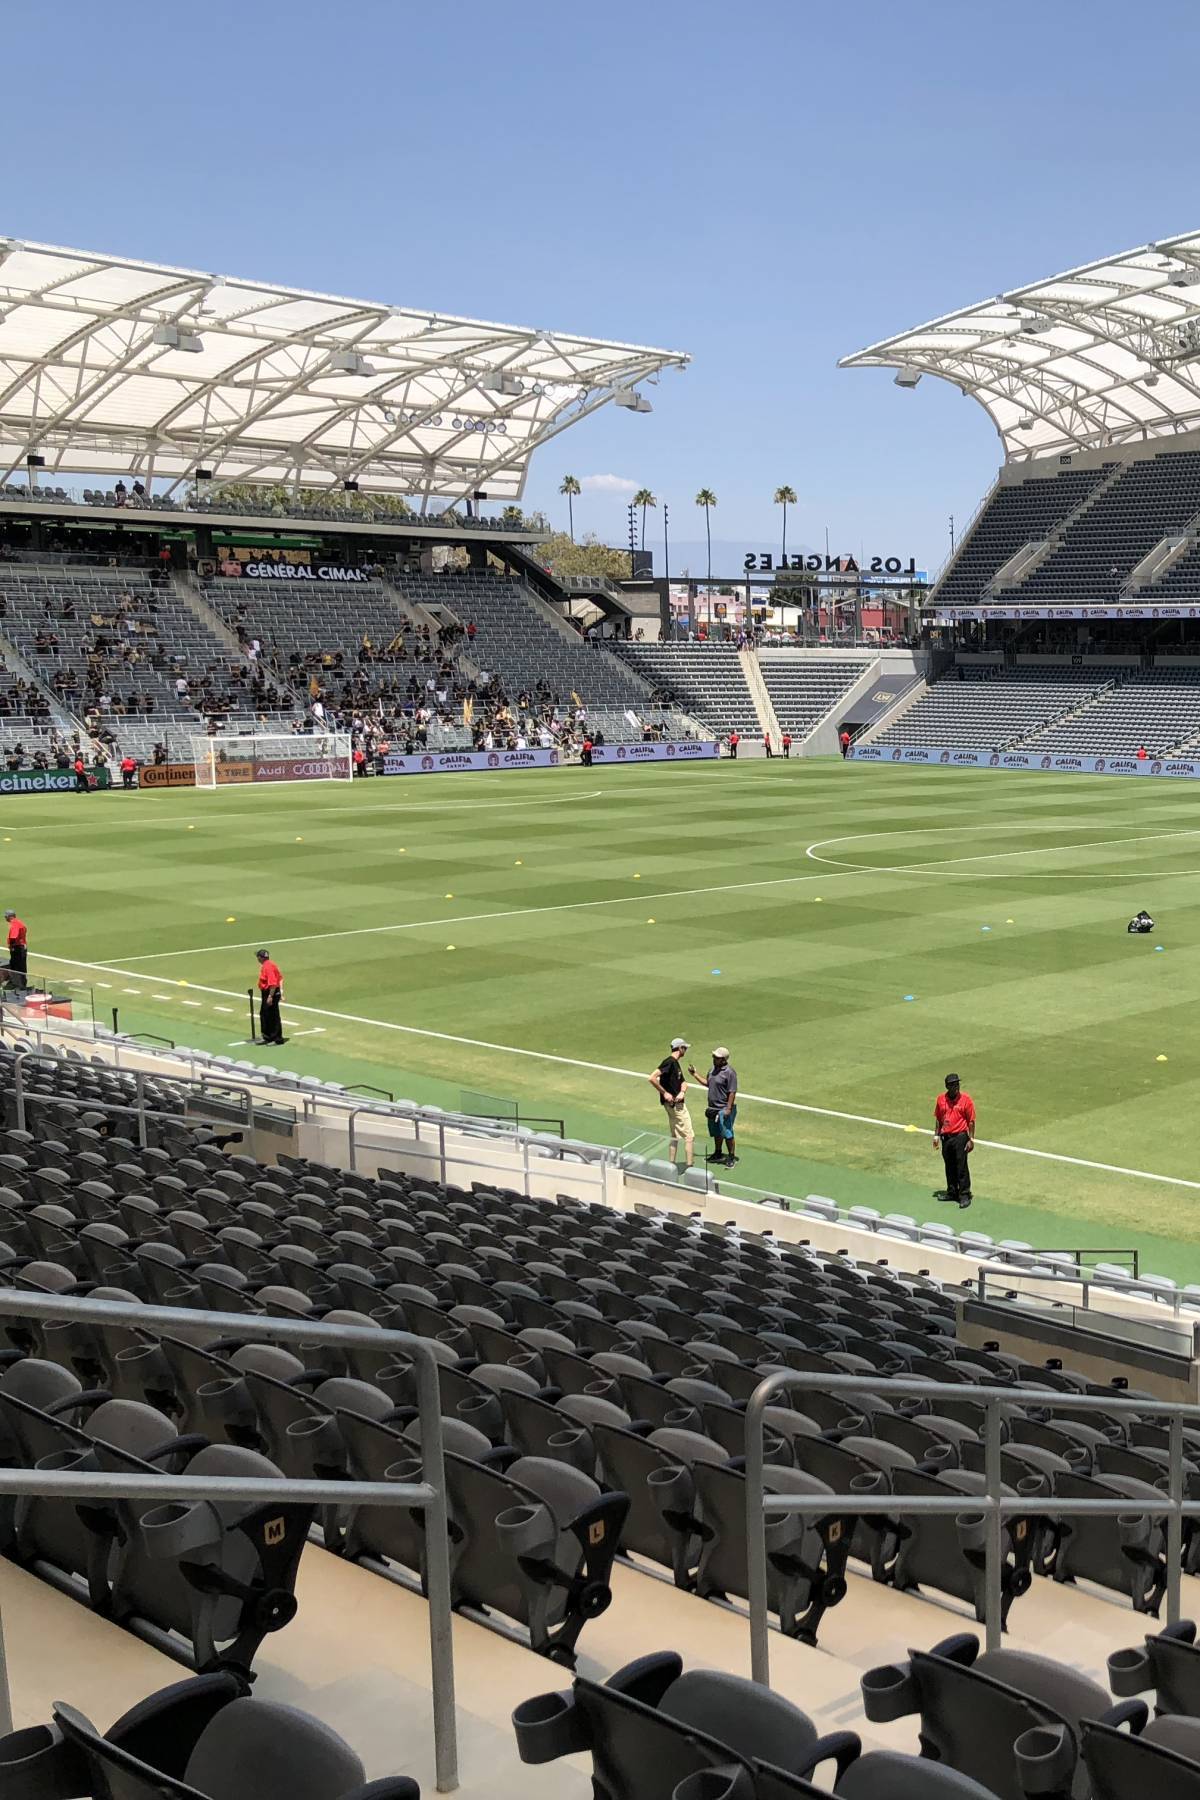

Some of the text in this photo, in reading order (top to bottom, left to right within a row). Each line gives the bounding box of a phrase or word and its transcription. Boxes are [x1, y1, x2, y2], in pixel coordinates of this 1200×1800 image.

[246, 562, 316, 579] GÉNÉRAL
[505, 751, 535, 762] CALIFIA
[859, 749, 881, 757] CALIFIA
[905, 751, 929, 759] CALIFIA
[954, 753, 978, 762] CALIFIA
[440, 755, 472, 765] CALIFIA
[1004, 755, 1029, 764] CALIFIA
[1056, 758, 1082, 767] CALIFIA
[1110, 761, 1137, 769] CALIFIA
[1166, 763, 1194, 773] CALIFIA
[225, 768, 249, 776] TIRE
[257, 766, 285, 776] Audi
[269, 1523, 280, 1539] M
